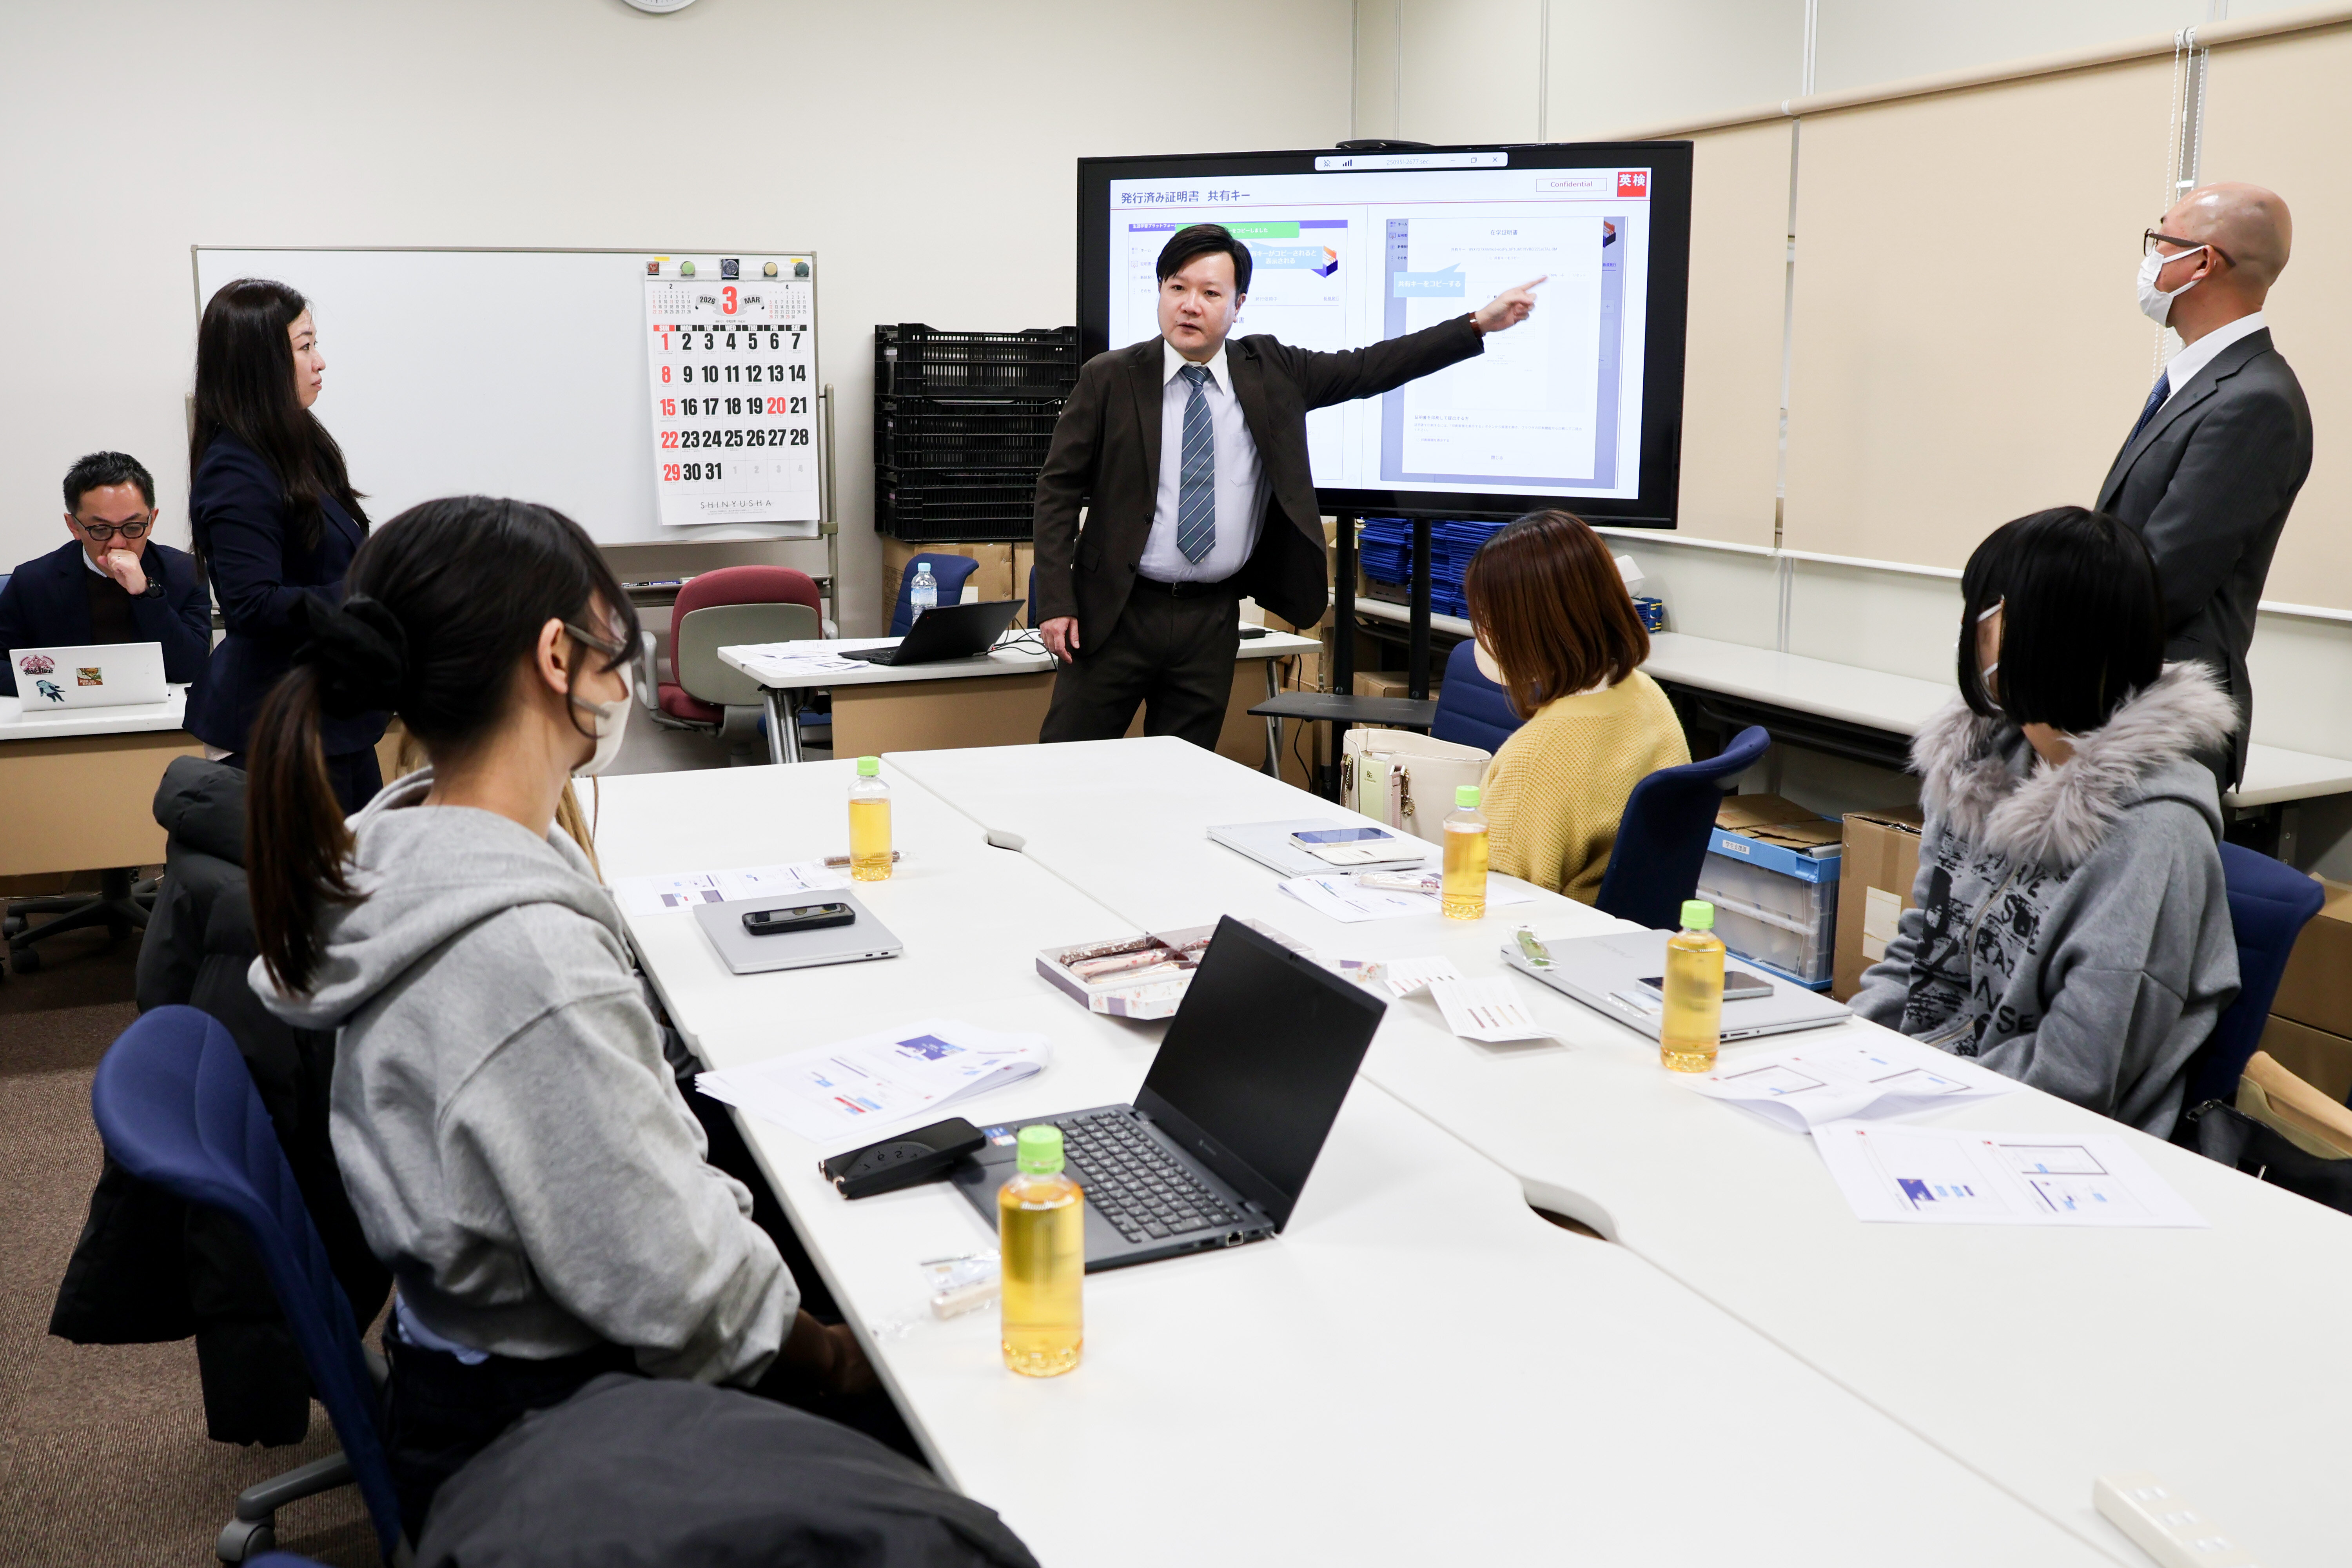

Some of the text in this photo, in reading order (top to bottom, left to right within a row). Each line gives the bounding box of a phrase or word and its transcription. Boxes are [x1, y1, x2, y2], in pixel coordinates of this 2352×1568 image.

[1619, 174, 1646, 187] 英検
[1121, 190, 1250, 204] 発行済み証明書 共有キー
[1398, 279, 1461, 289] 共有キーをコピーする
[722, 287, 737, 314] 3
[662, 332, 800, 350] 1 2 3 4 5 6 7
[662, 365, 806, 383] 8 9 10 11 12 13 14
[660, 397, 807, 416] 15 16 17 18 19 20 21
[661, 428, 809, 449] 22 23 24 25 26 27 28
[664, 464, 680, 481] 29
[683, 463, 701, 482] 30
[705, 463, 721, 480] 31
[700, 499, 772, 509] SHINYUSHA
